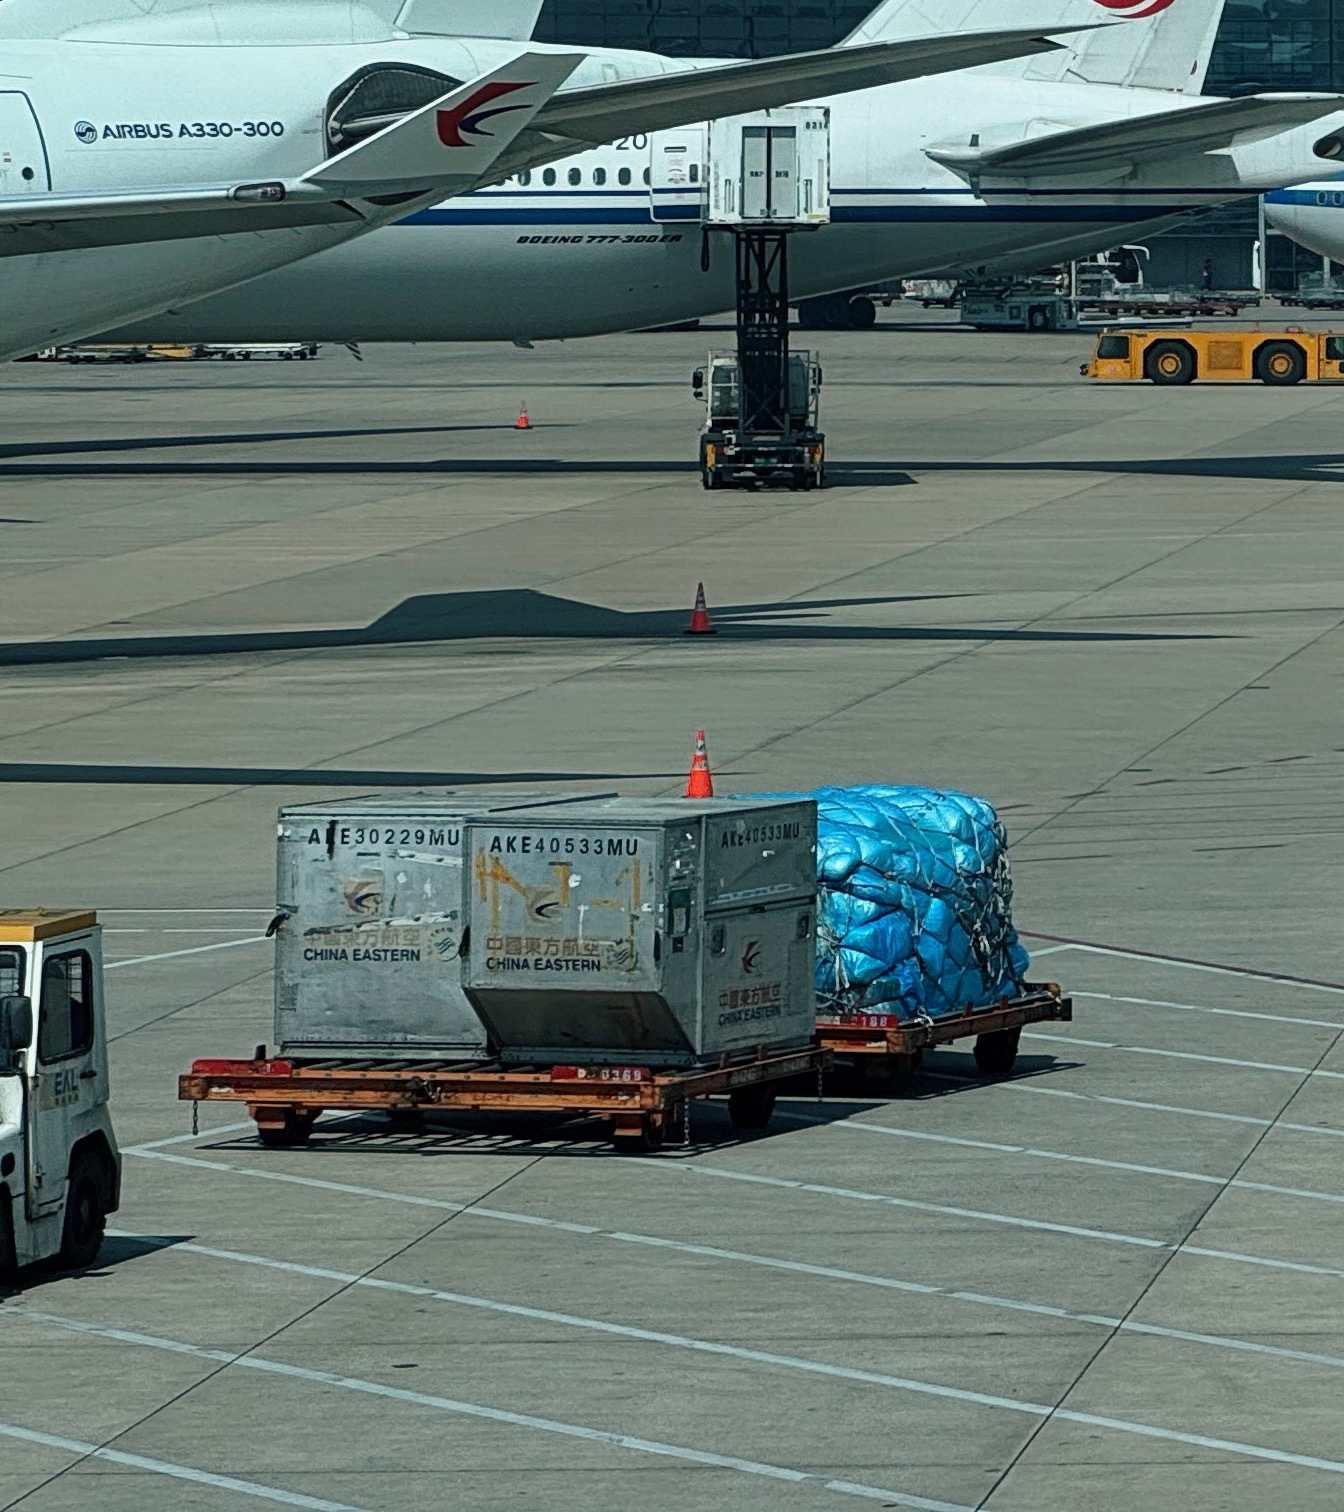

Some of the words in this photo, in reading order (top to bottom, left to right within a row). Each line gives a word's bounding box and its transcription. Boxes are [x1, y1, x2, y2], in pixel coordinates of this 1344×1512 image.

[102, 123, 173, 139] AIRBUS
[178, 121, 285, 138] A330-300
[516, 235, 584, 244] BOEING
[490, 836, 638, 856] AKE40533MU
[304, 948, 348, 961] CHINA
[352, 948, 421, 962] EASTERN
[486, 957, 530, 970] CHINA
[534, 958, 601, 972] EASTERN
